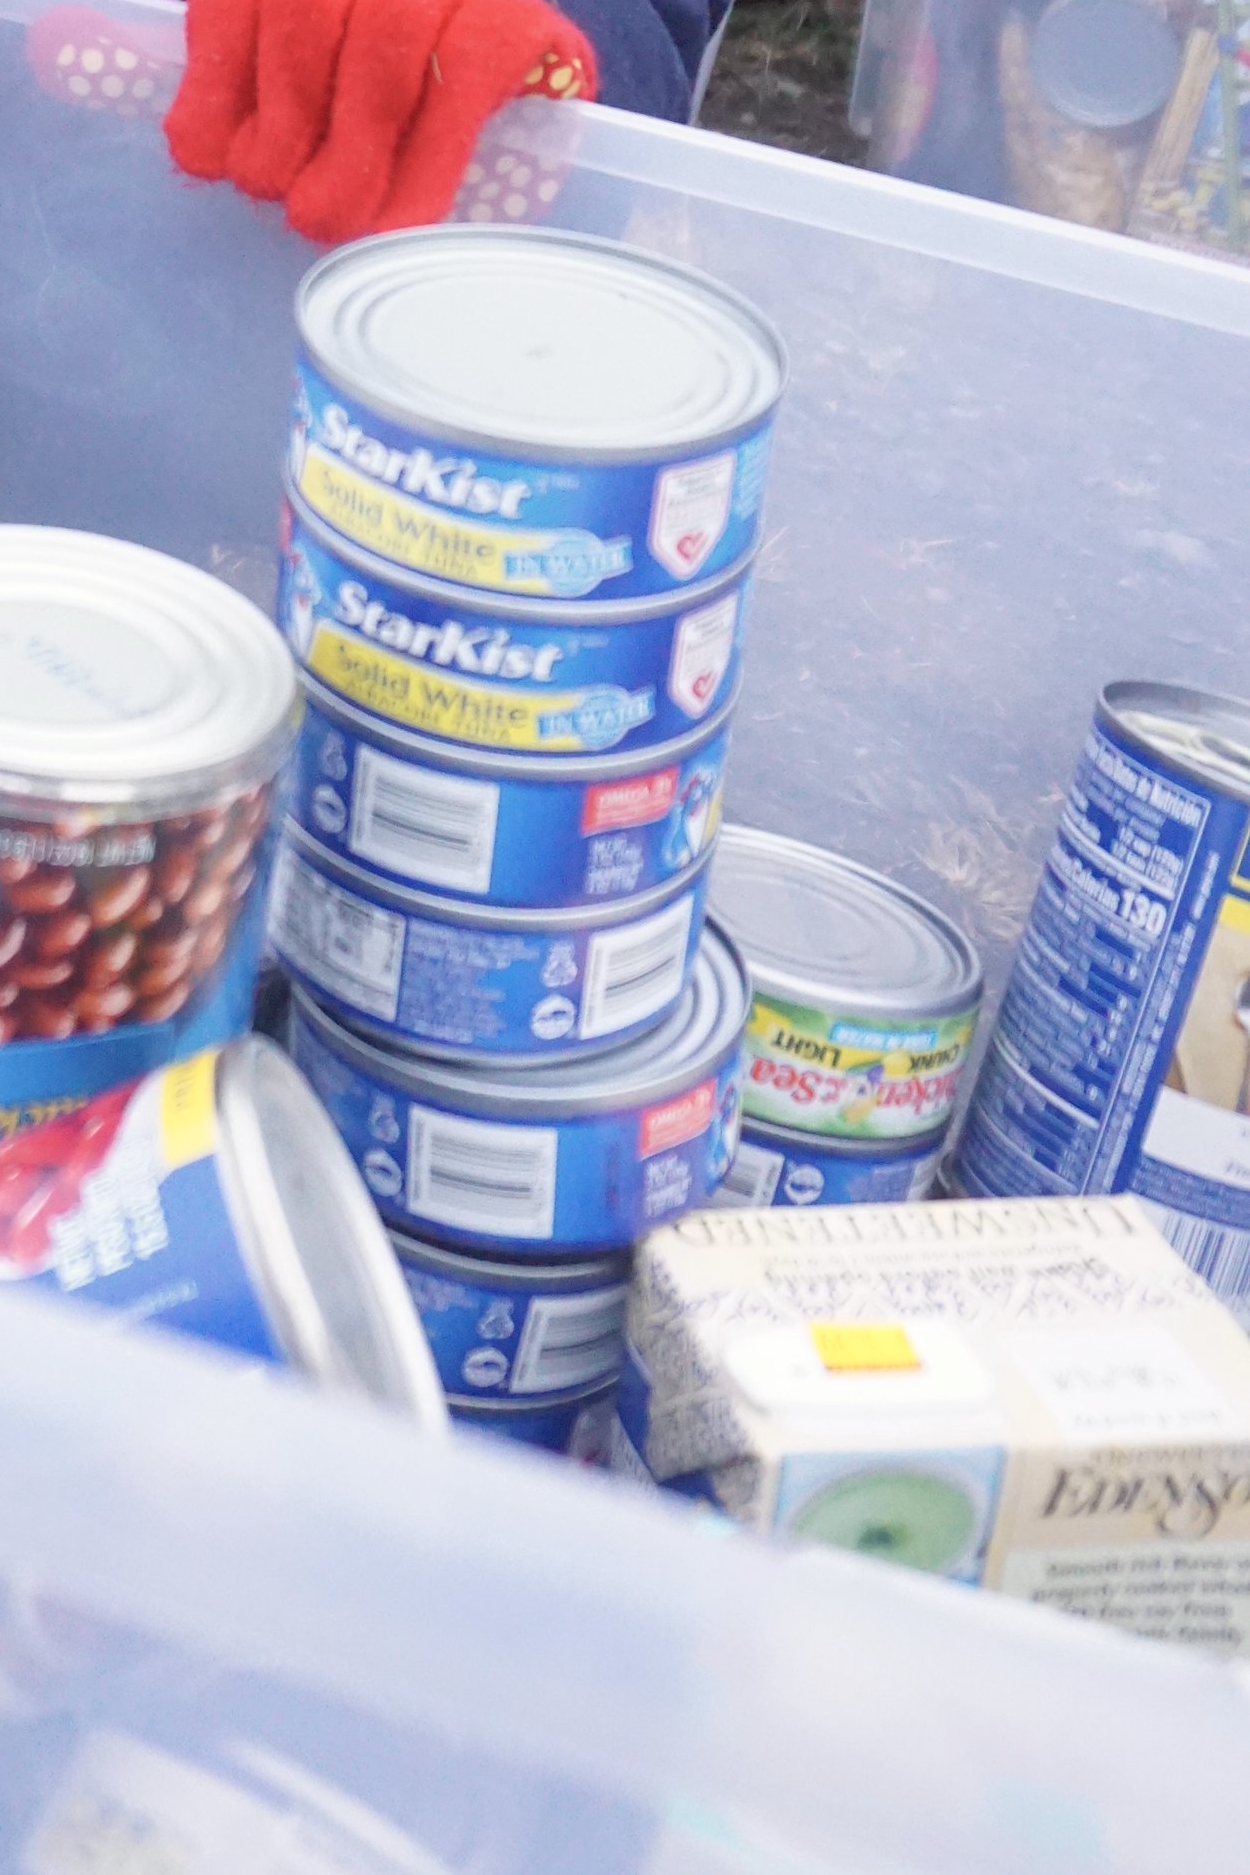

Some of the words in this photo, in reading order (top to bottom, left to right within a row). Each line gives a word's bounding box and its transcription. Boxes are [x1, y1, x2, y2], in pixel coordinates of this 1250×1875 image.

[321, 401, 532, 521] StarKist
[321, 469, 385, 528] Solid
[391, 511, 497, 561] White
[334, 579, 564, 683] StarKist
[337, 643, 410, 696] Solid
[422, 682, 530, 731] White
[1120, 888, 1168, 938] 130
[750, 1053, 826, 1106] Sea
[770, 1029, 844, 1068] LIGHT
